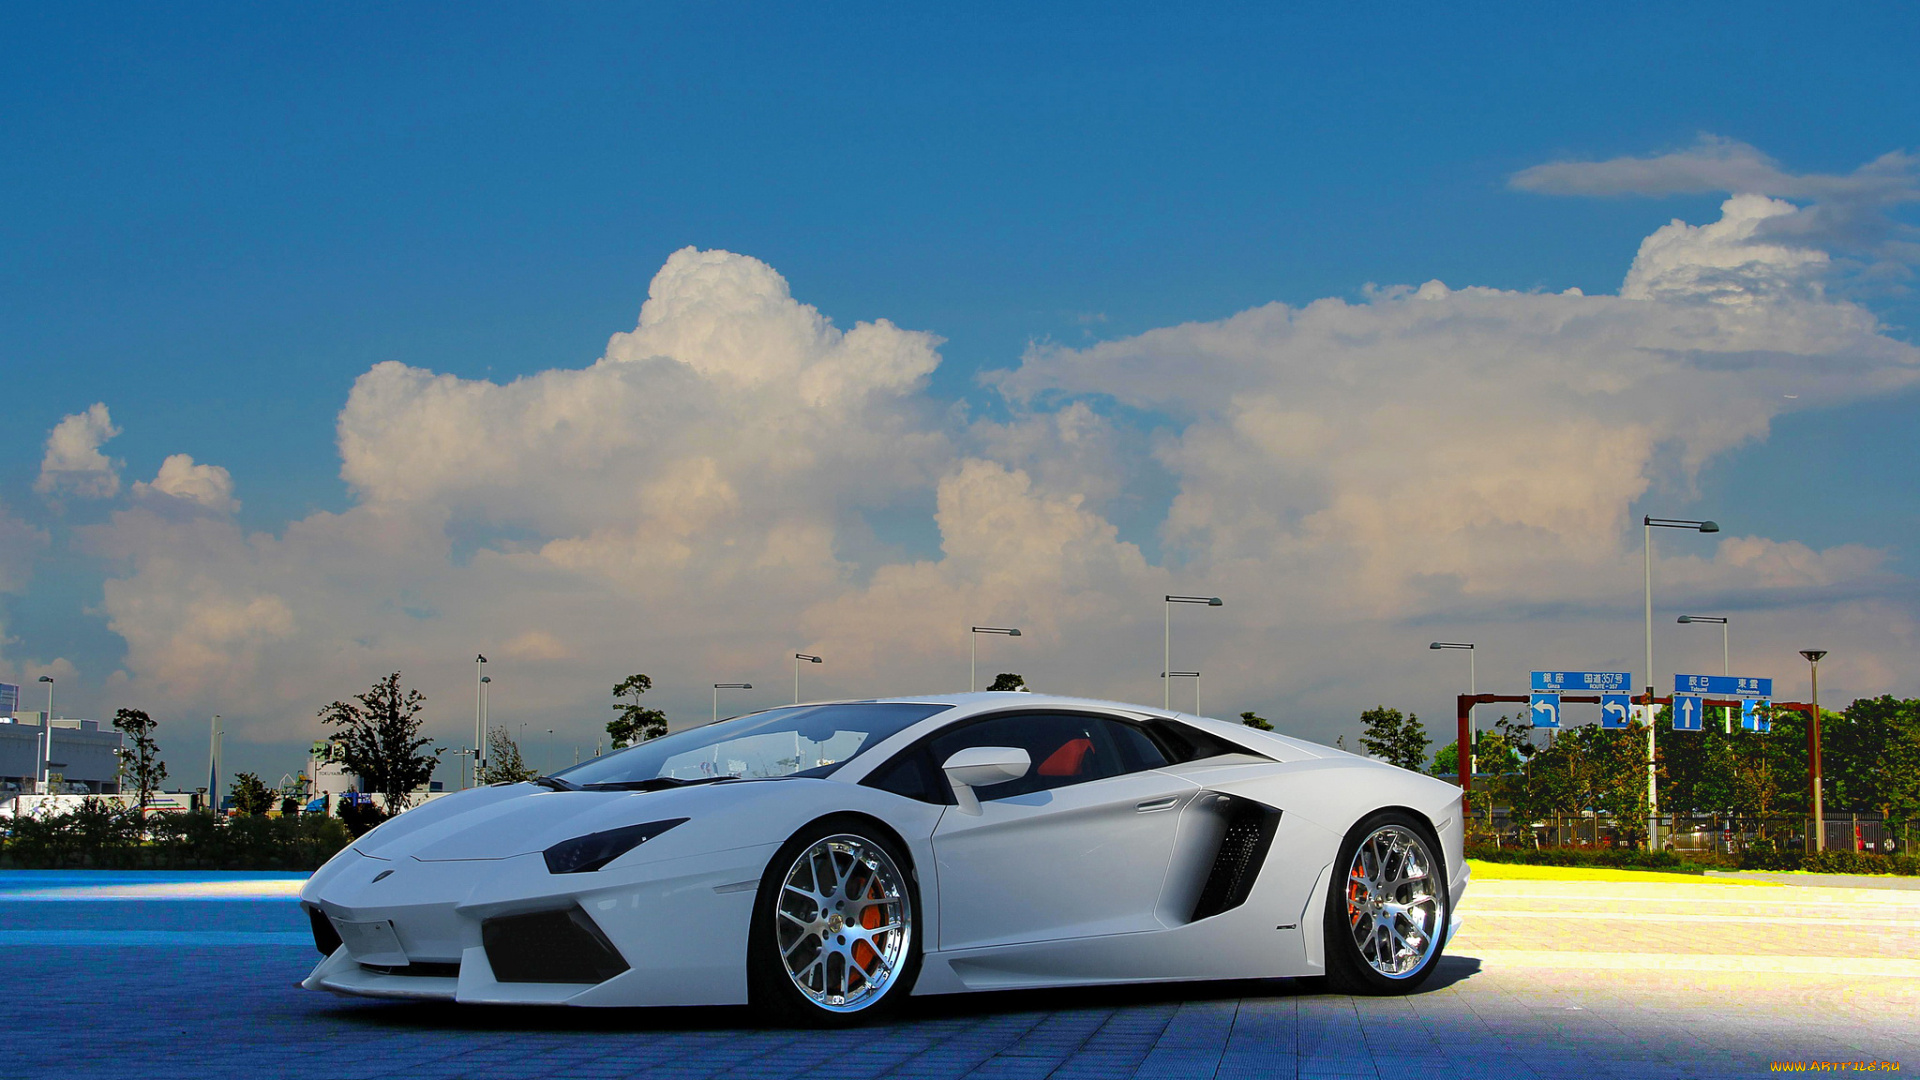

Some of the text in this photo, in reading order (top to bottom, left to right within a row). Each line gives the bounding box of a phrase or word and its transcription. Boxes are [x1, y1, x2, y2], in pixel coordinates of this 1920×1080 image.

[1543, 673, 1564, 683] 銀座
[1584, 674, 1623, 684] 国道357号
[1738, 679, 1758, 689] 東雲
